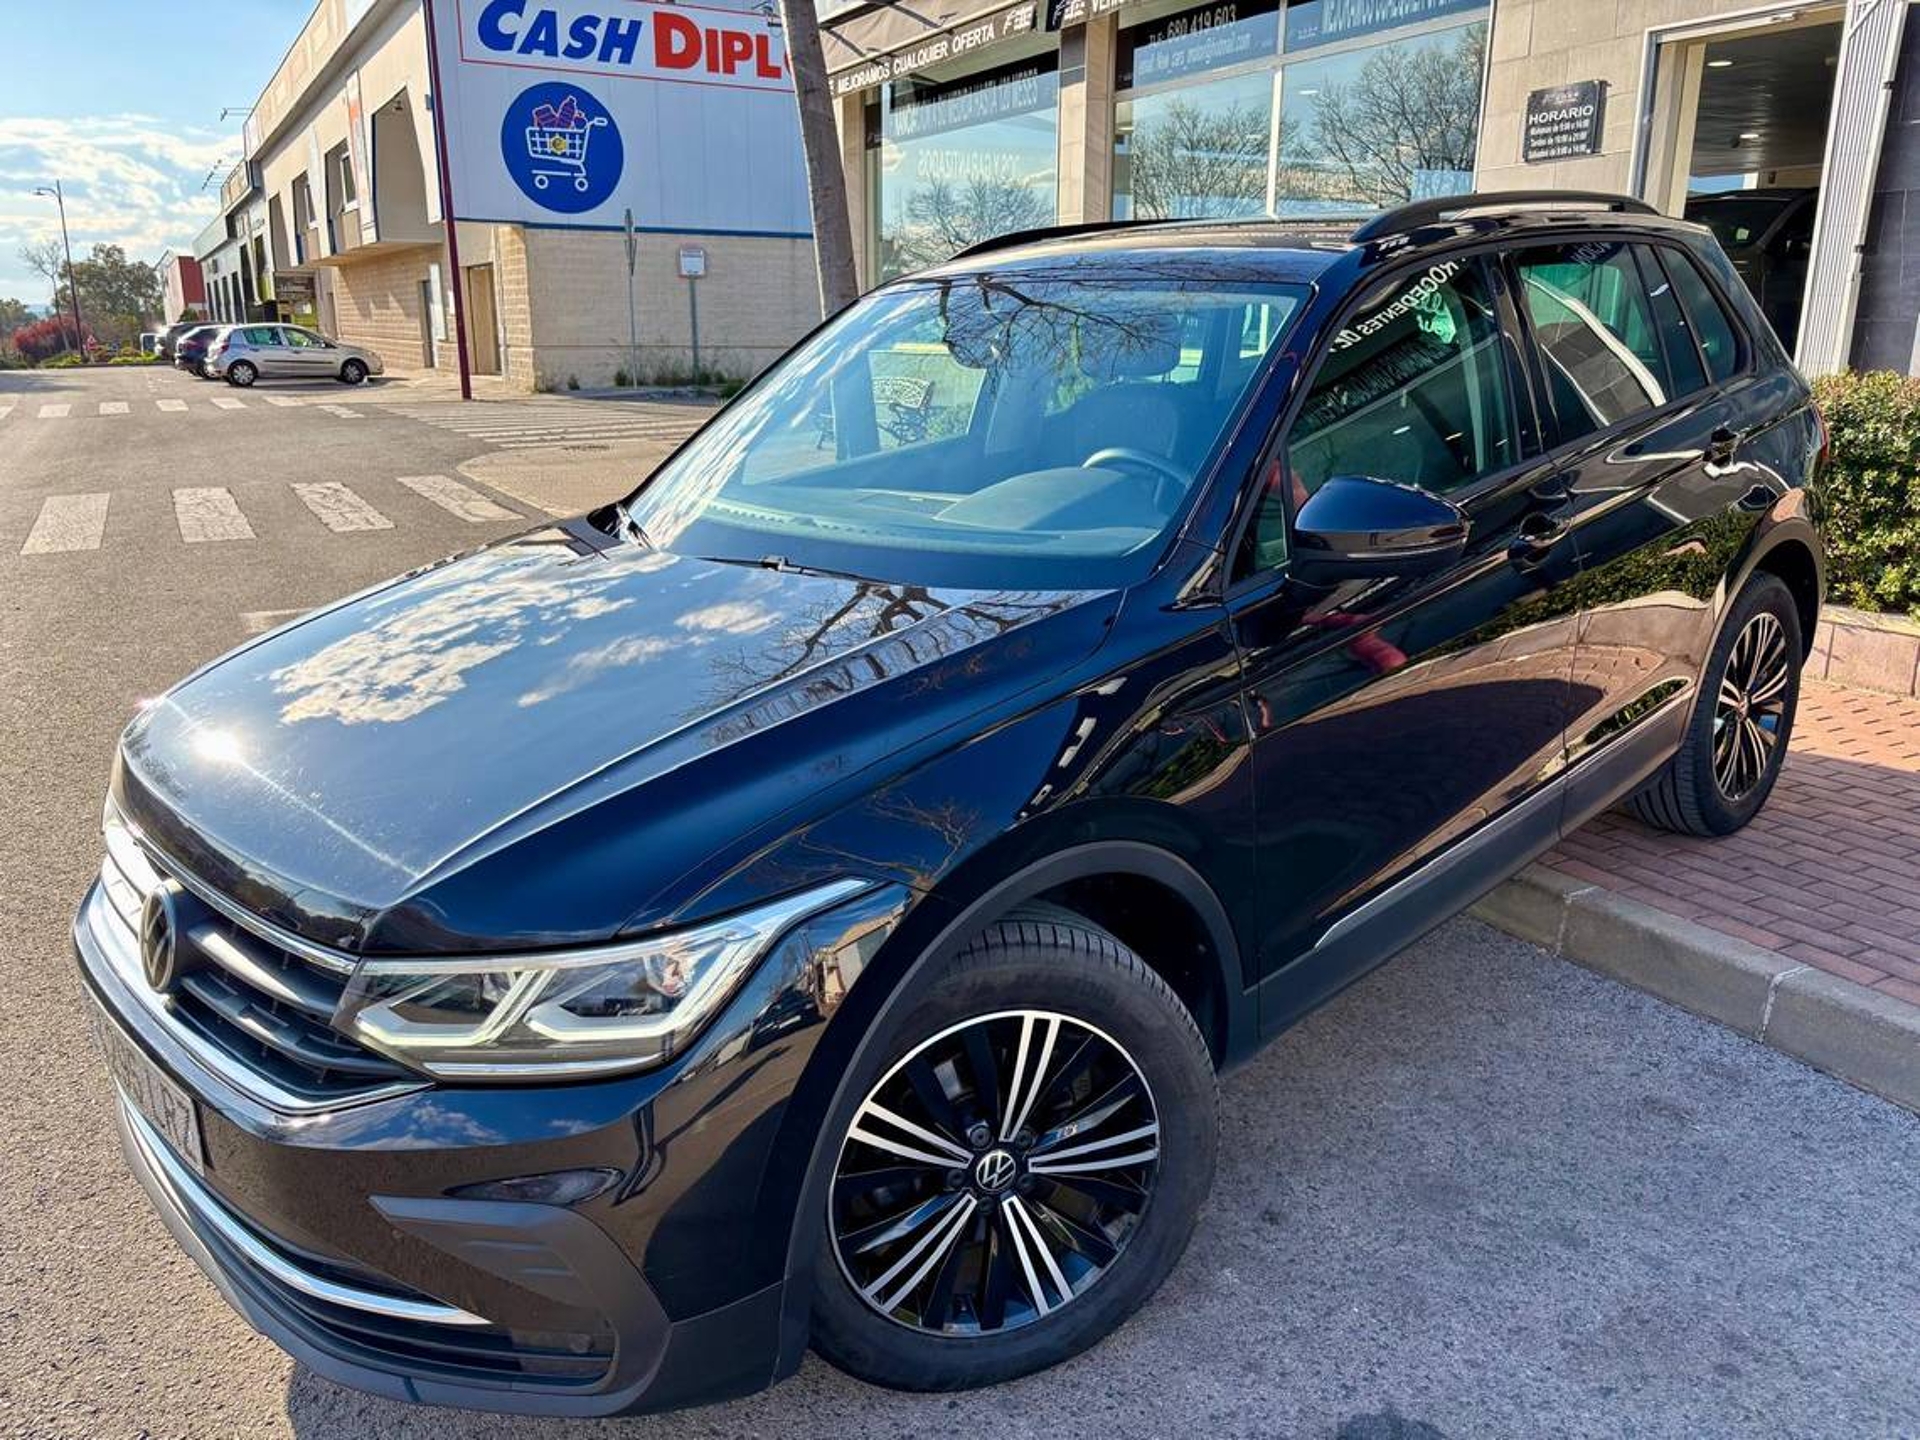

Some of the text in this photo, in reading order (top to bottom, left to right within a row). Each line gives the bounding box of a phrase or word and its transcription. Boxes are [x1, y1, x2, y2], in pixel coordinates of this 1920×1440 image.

[478, 0, 793, 79] CASH DIPL
[1190, 10, 1211, 36] 419
[1213, 4, 1237, 30] 603
[837, 65, 890, 94] MEJORAMOS
[893, 41, 949, 74] CUALQUIER
[952, 23, 995, 52] OFERTA
[1529, 105, 1594, 125] HORARIO
